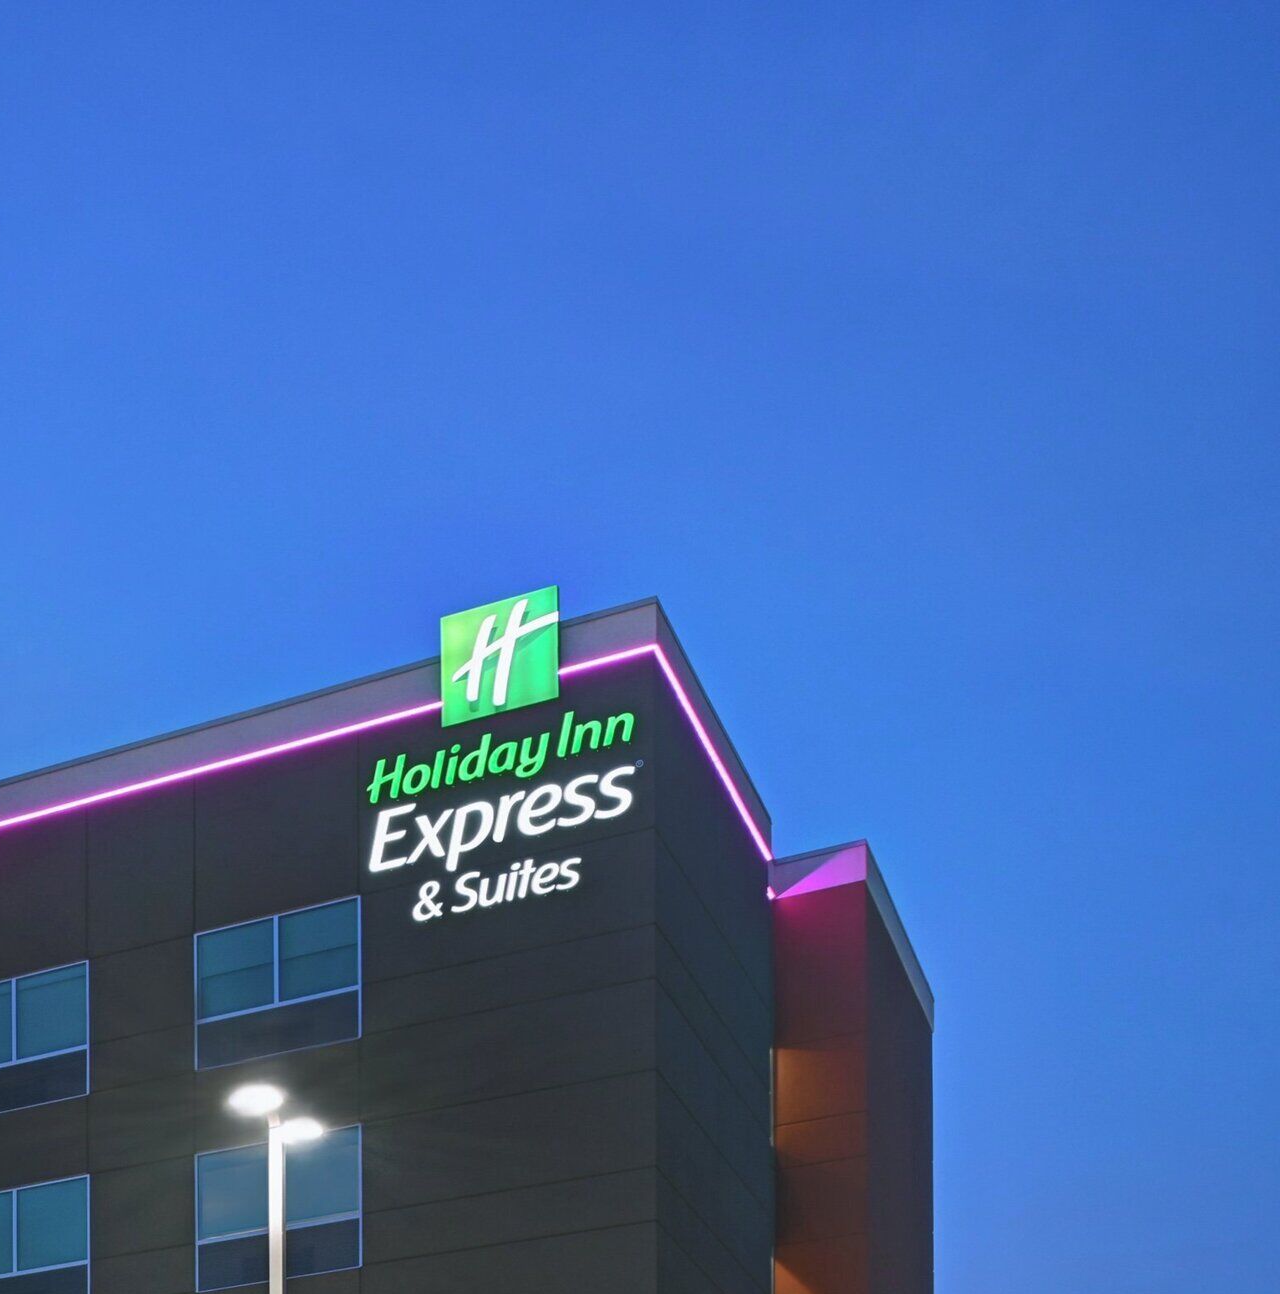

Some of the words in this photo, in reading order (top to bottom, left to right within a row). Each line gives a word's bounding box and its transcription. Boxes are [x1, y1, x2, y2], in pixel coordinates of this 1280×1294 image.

[367, 733, 550, 803] Holiday
[557, 711, 635, 758] Inn
[368, 765, 636, 873] Express
[411, 880, 444, 922] &
[450, 857, 583, 914] Suites
